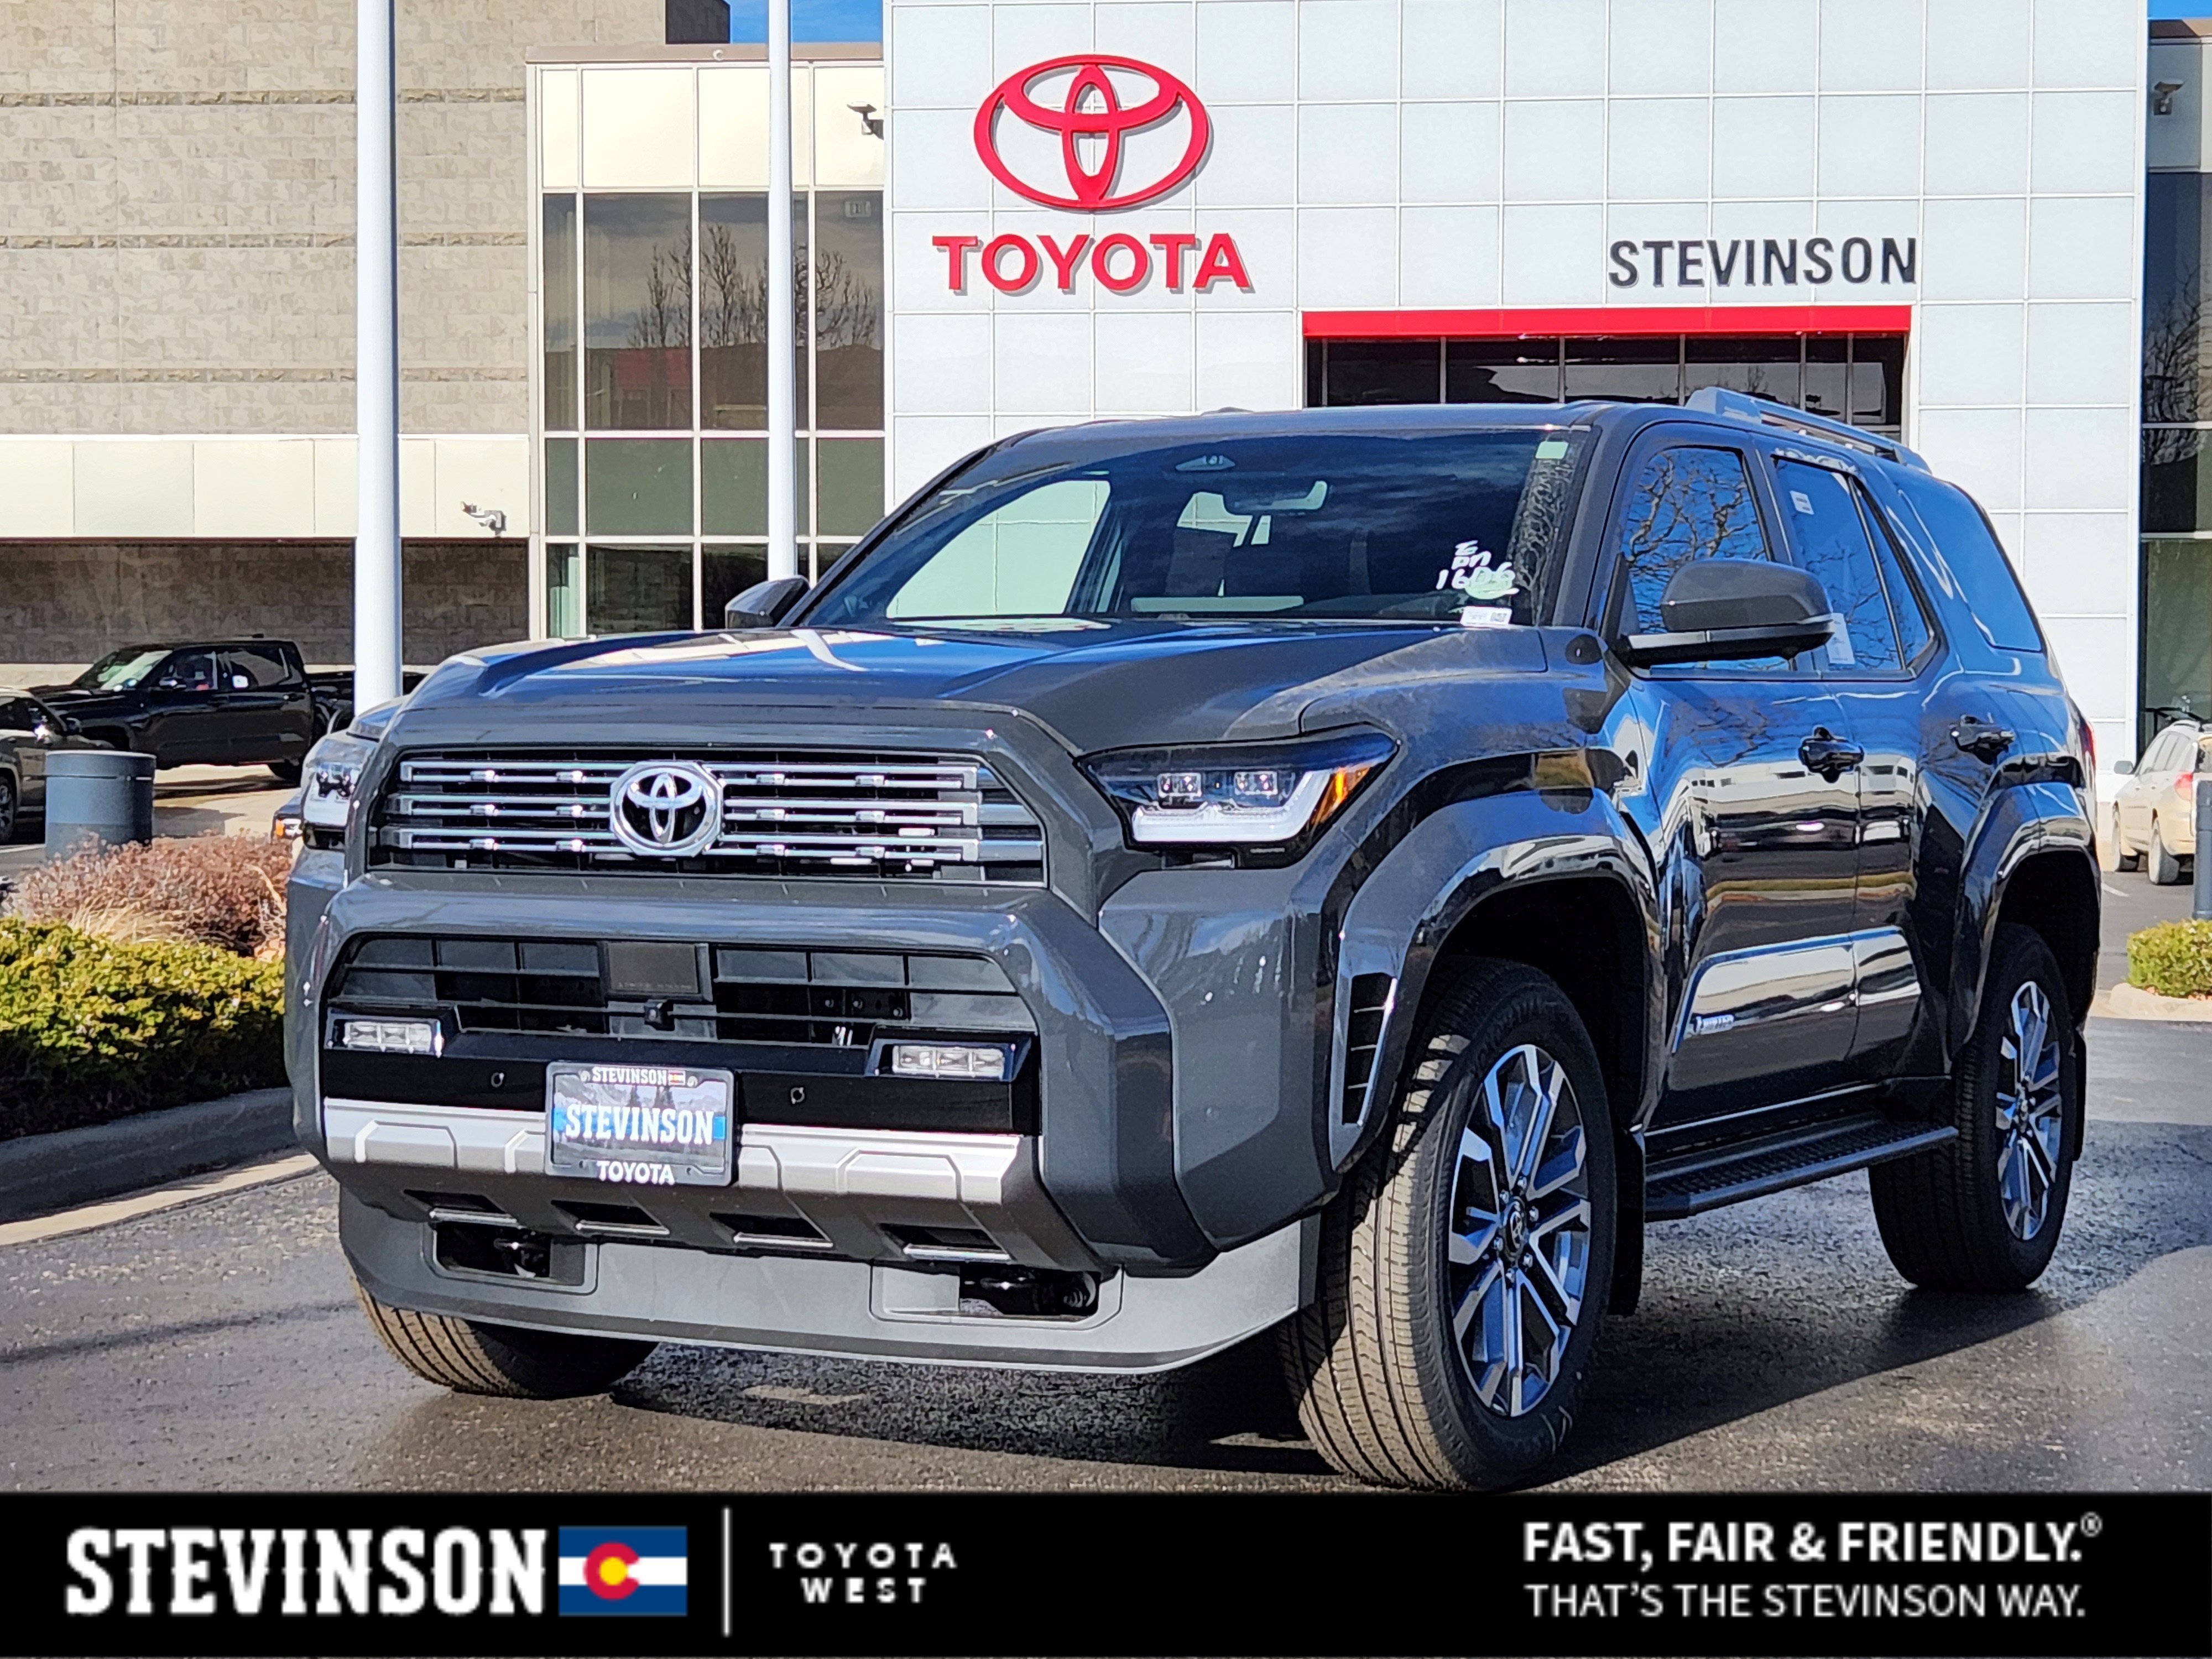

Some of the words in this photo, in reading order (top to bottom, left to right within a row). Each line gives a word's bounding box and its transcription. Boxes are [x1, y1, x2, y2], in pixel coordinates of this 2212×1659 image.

[932, 233, 1250, 292] TOYOTA
[1608, 237, 1917, 288] STEVINSON
[592, 1066, 668, 1085] STEVINSON
[565, 1103, 714, 1145] STEVINSON
[596, 1161, 675, 1186] TOYOTA
